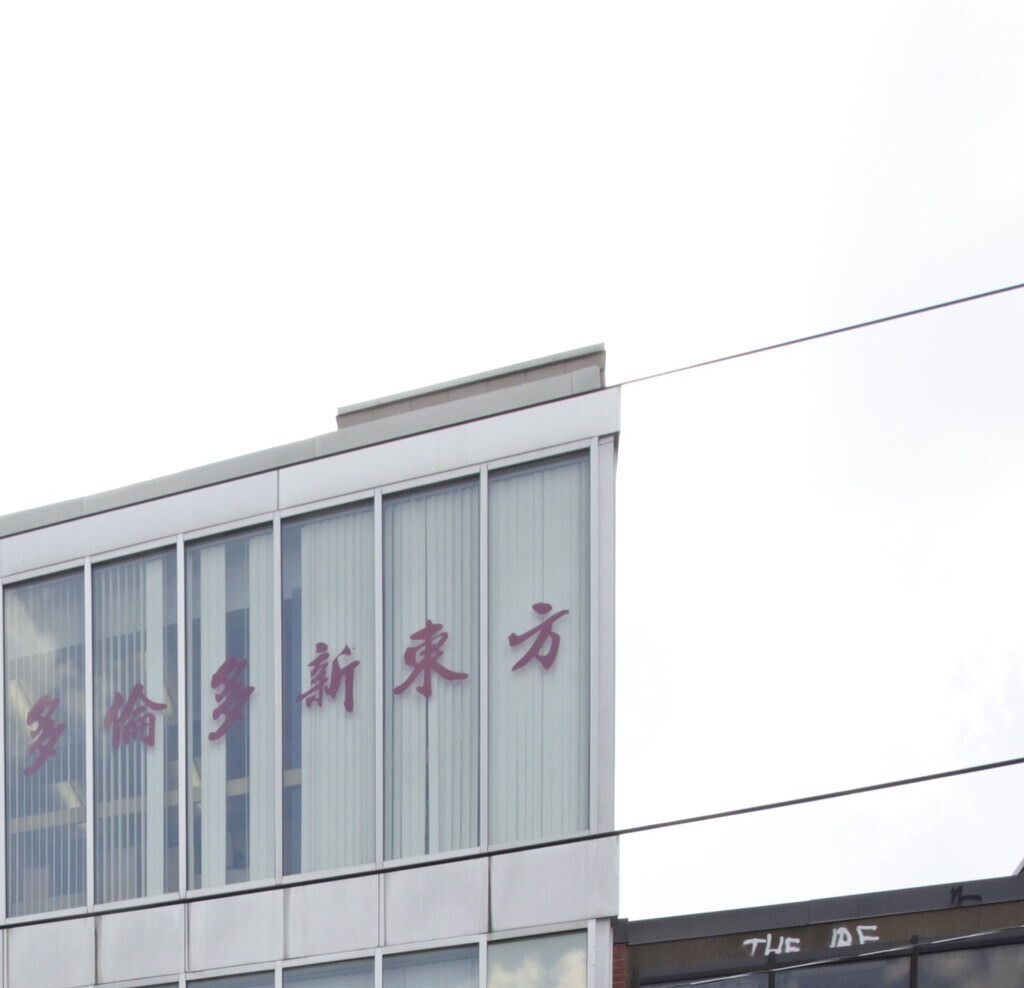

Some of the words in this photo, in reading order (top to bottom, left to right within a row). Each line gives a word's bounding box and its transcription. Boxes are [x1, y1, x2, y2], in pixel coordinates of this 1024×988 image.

[23, 602, 569, 775] 多倫多新東方
